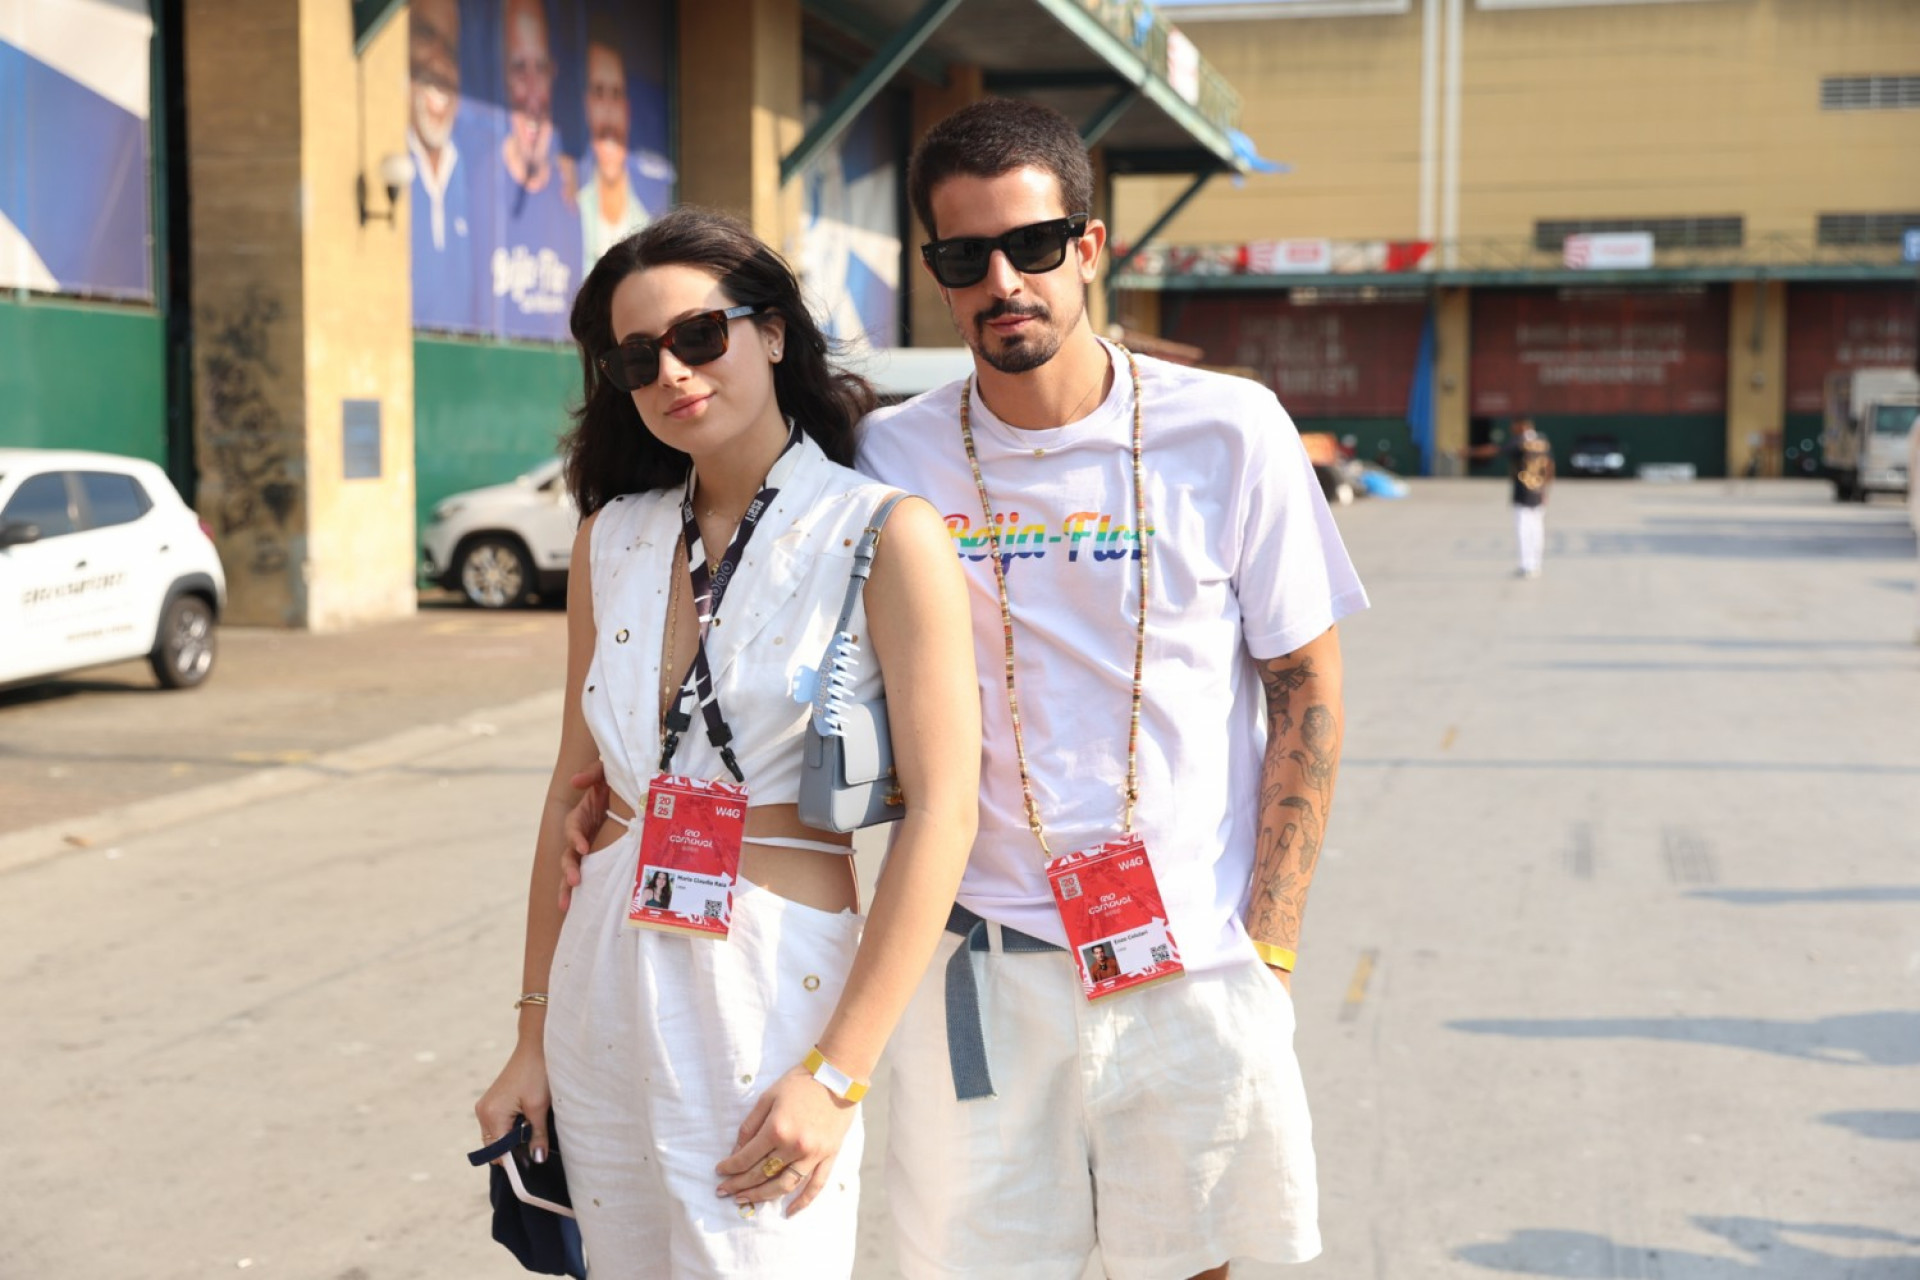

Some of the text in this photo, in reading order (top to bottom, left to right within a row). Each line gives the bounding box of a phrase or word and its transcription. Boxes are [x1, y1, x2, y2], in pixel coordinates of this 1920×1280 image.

[658, 796, 670, 806] 20
[715, 806, 741, 819] W4G
[1118, 856, 1144, 871] W4G
[1063, 877, 1075, 887] 20
